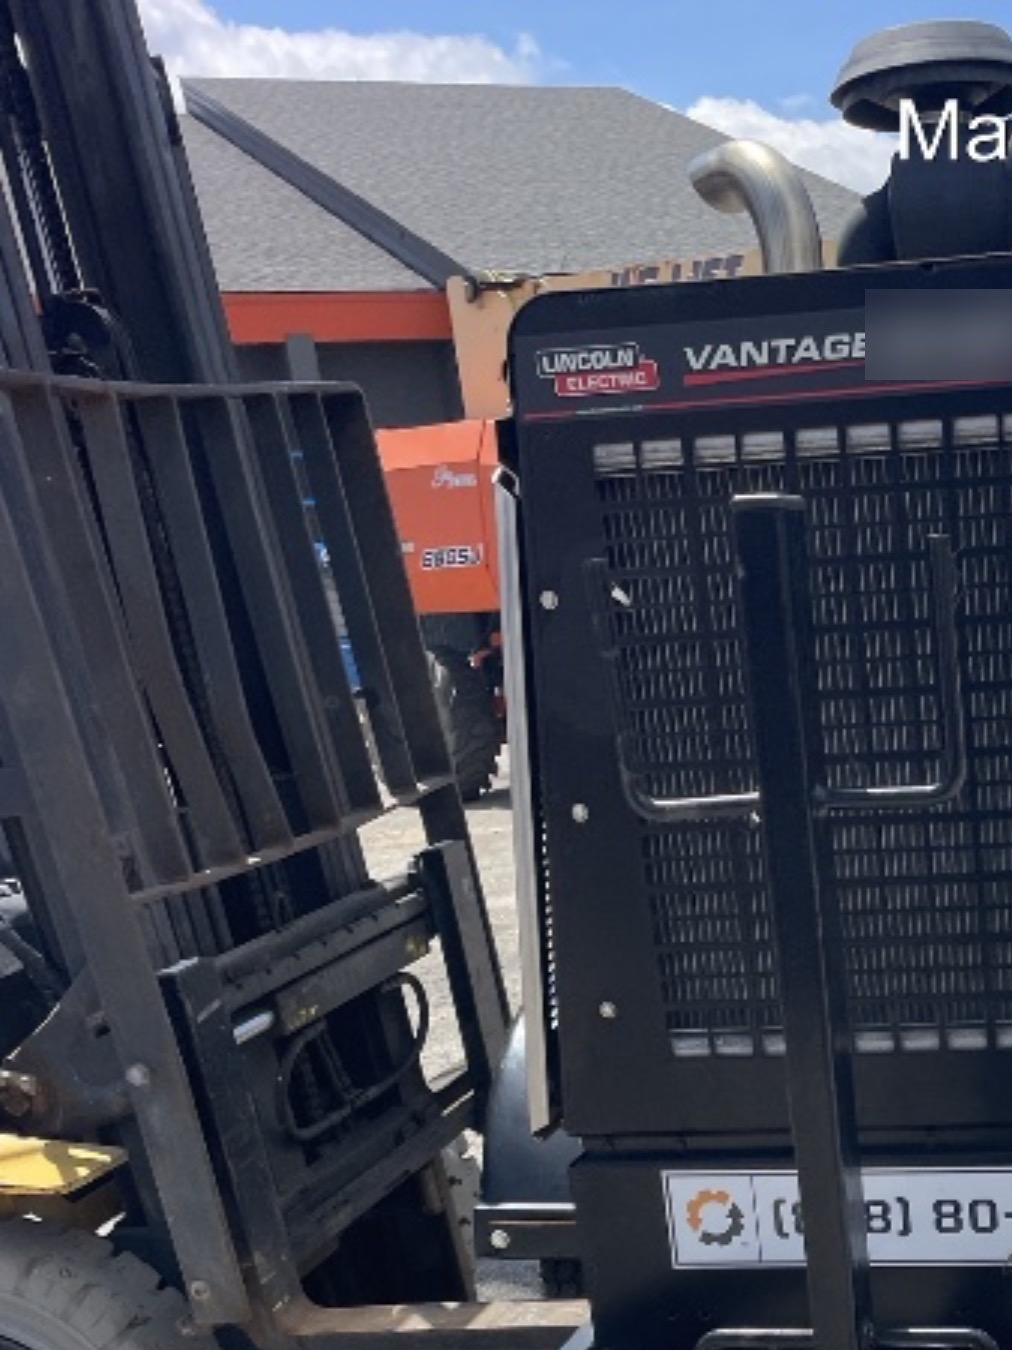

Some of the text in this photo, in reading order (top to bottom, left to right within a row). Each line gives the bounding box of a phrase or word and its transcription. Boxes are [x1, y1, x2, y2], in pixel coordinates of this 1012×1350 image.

[541, 348, 635, 373] LINCOLN
[683, 332, 866, 371] VANTAGE
[566, 371, 647, 391] ELECTRIC
[773, 1197, 912, 1239] (8)
